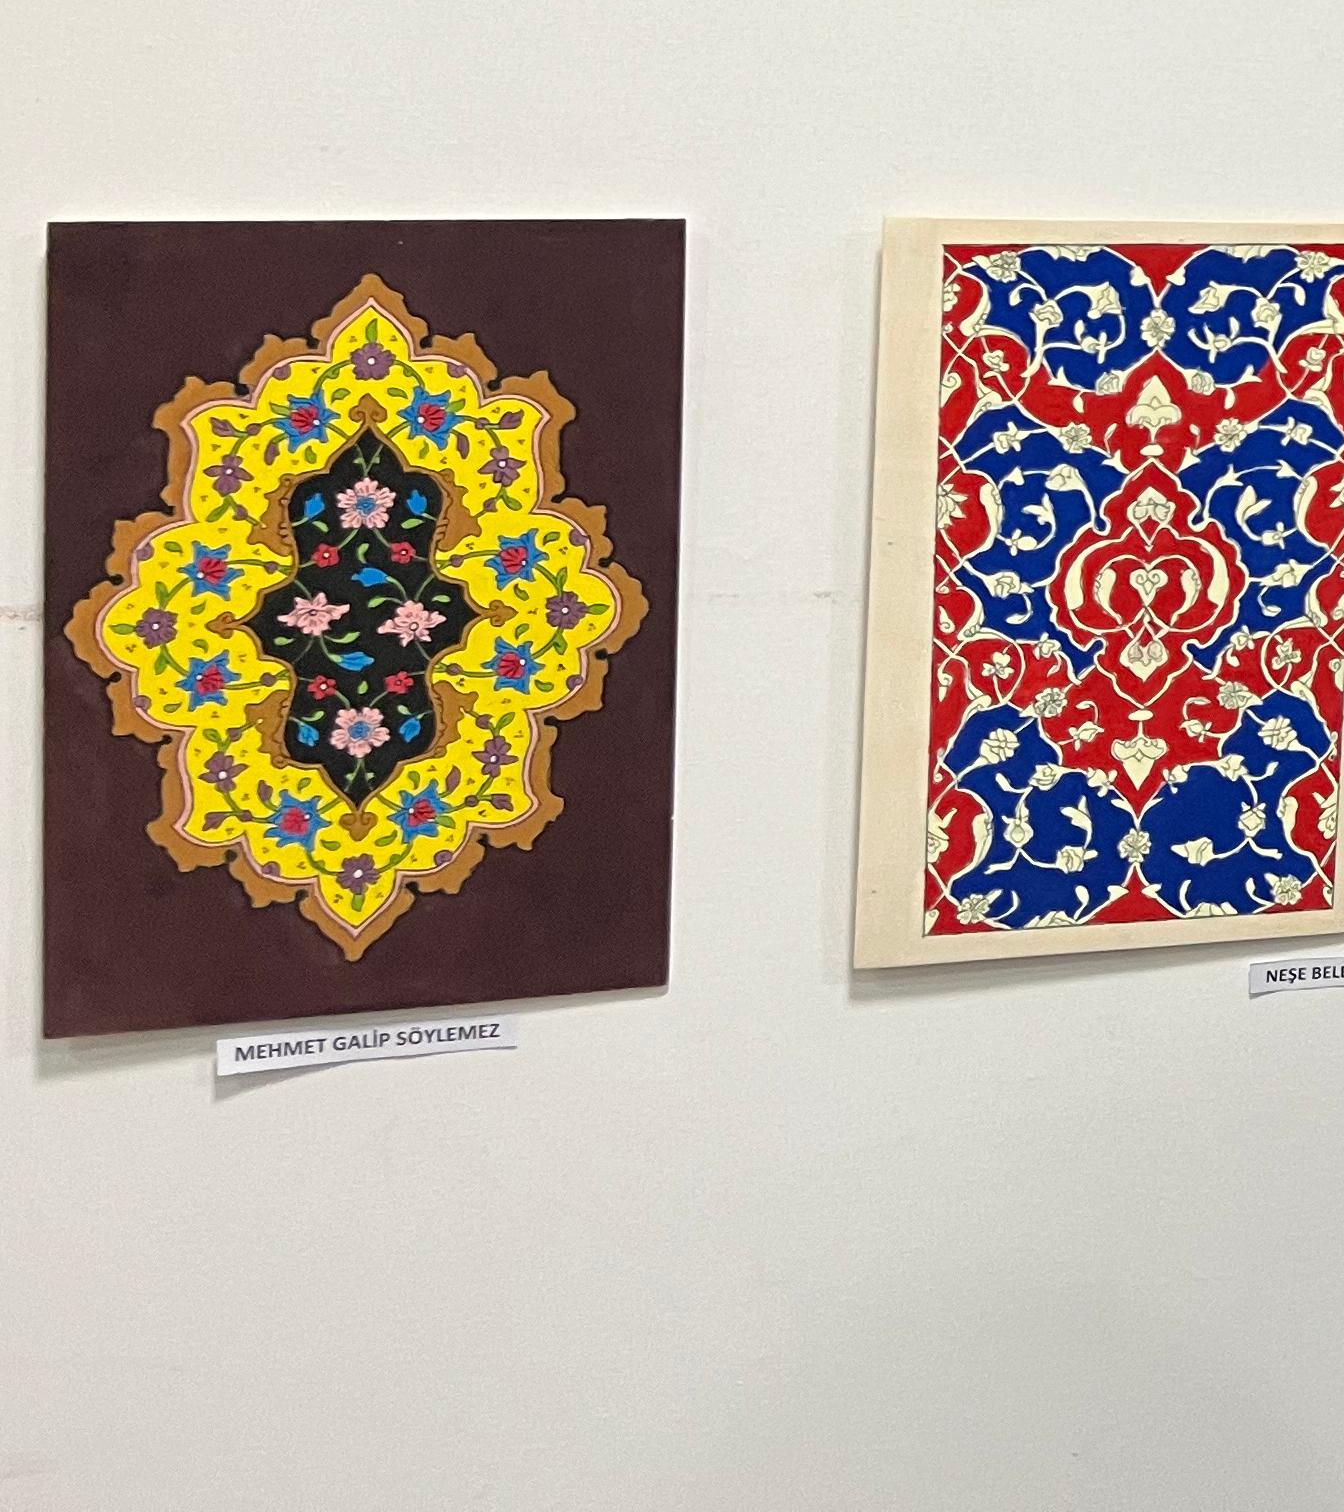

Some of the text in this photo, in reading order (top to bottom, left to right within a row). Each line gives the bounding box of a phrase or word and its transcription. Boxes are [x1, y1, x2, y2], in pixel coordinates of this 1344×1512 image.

[1266, 967, 1306, 984] NEŞE
[235, 1023, 500, 1062] MEHMET GALİP SÖYLEMEZ
